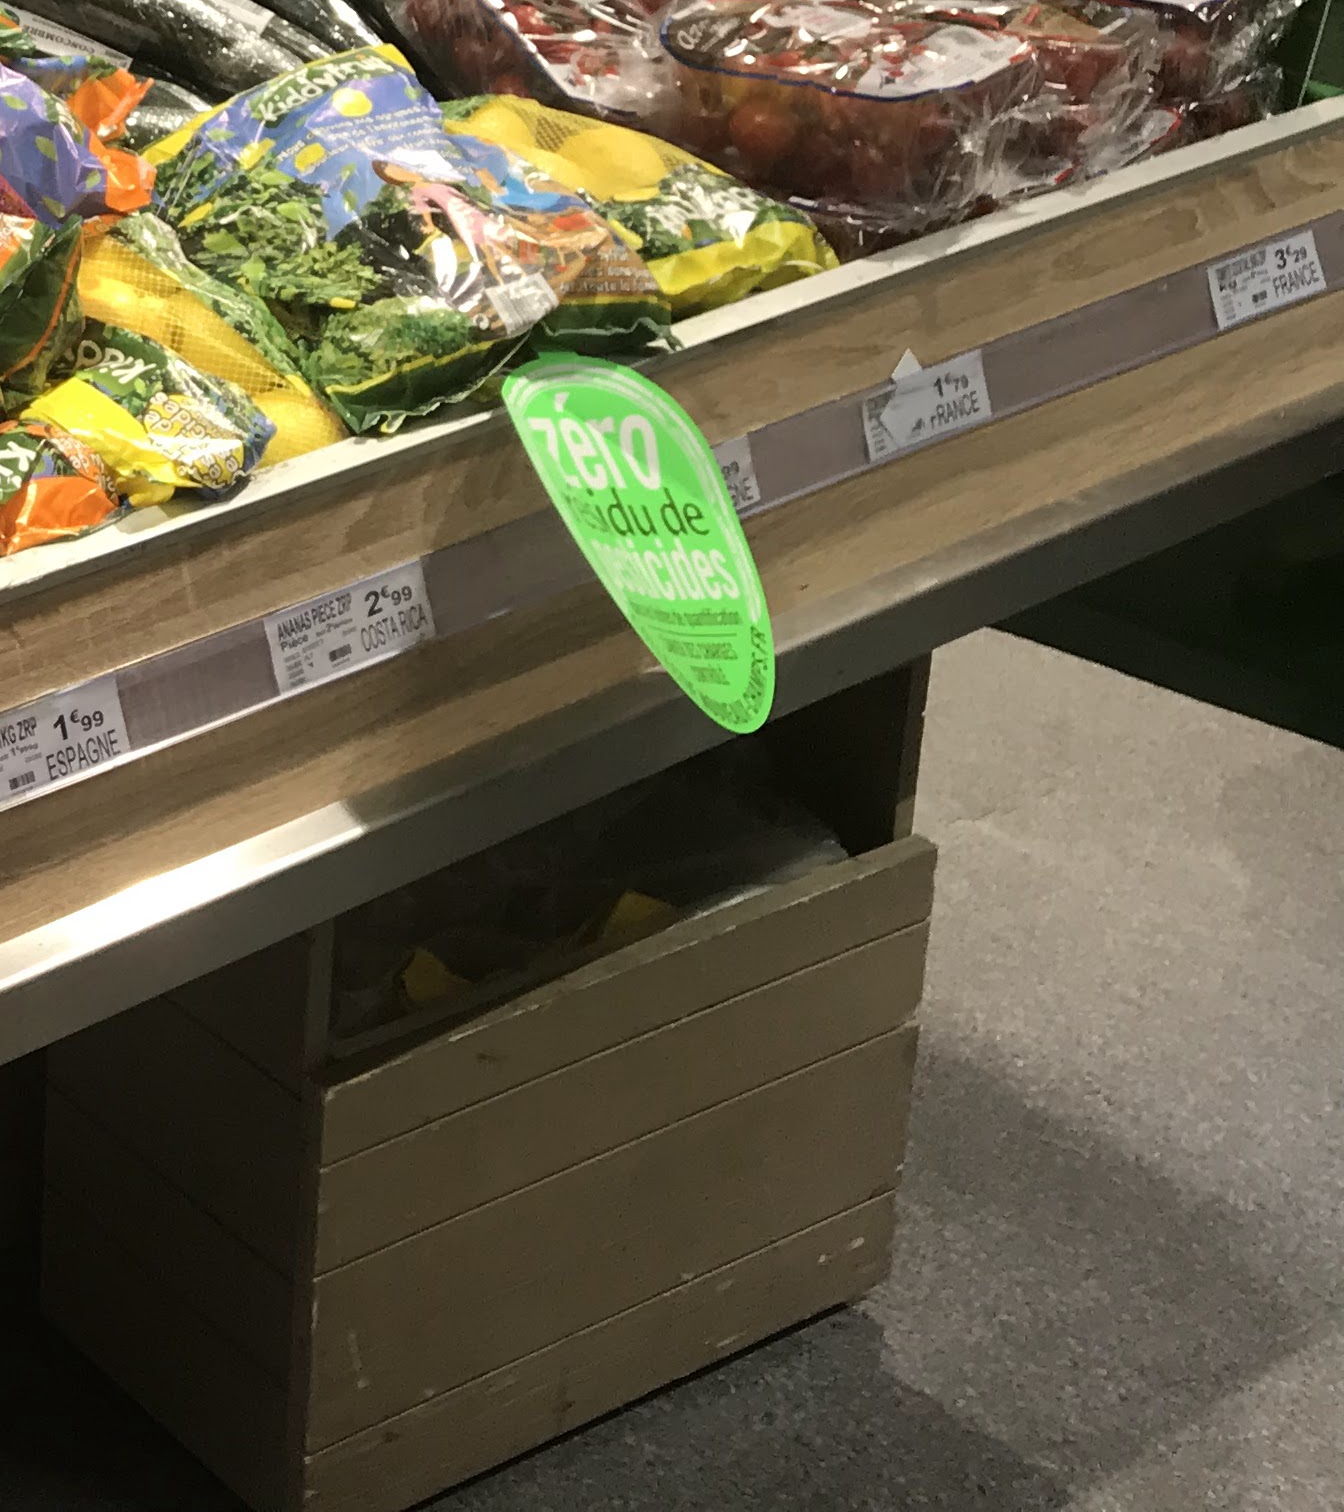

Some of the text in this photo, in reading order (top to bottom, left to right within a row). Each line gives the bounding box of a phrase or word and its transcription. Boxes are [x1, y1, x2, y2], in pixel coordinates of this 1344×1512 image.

[1272, 261, 1320, 298] FRANCE
[527, 391, 662, 491] zéro
[663, 488, 711, 537] de
[364, 584, 413, 618] 2€99
[275, 610, 312, 641] ANANAS
[360, 603, 430, 653] COSTA RICA
[16, 716, 38, 741] ZRP
[53, 708, 104, 741] 1€99
[46, 729, 123, 781] ESPAGNE
